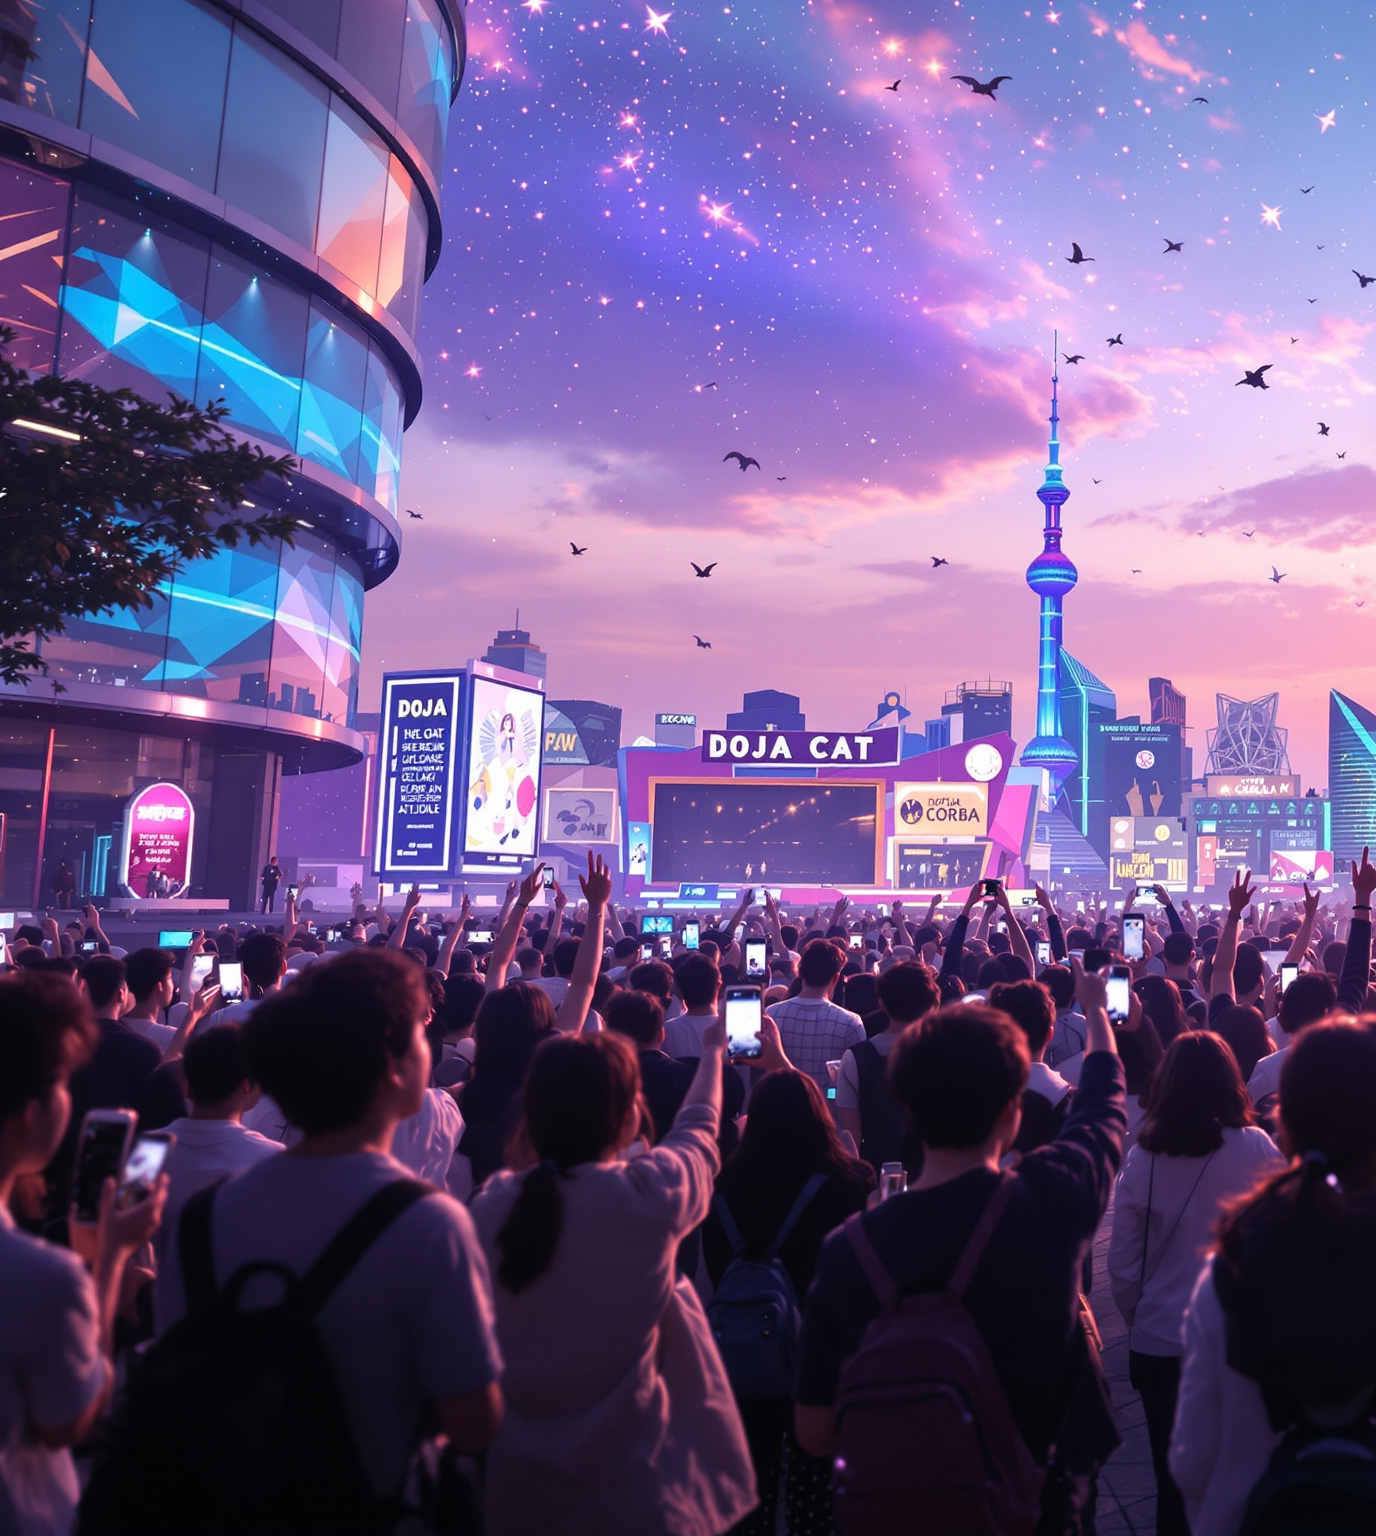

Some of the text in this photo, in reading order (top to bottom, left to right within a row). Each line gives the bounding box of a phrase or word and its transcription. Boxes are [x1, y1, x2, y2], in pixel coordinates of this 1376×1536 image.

[398, 698, 447, 718] DOJA
[709, 734, 874, 760] DOJA CAT
[926, 807, 980, 822] CORBA
